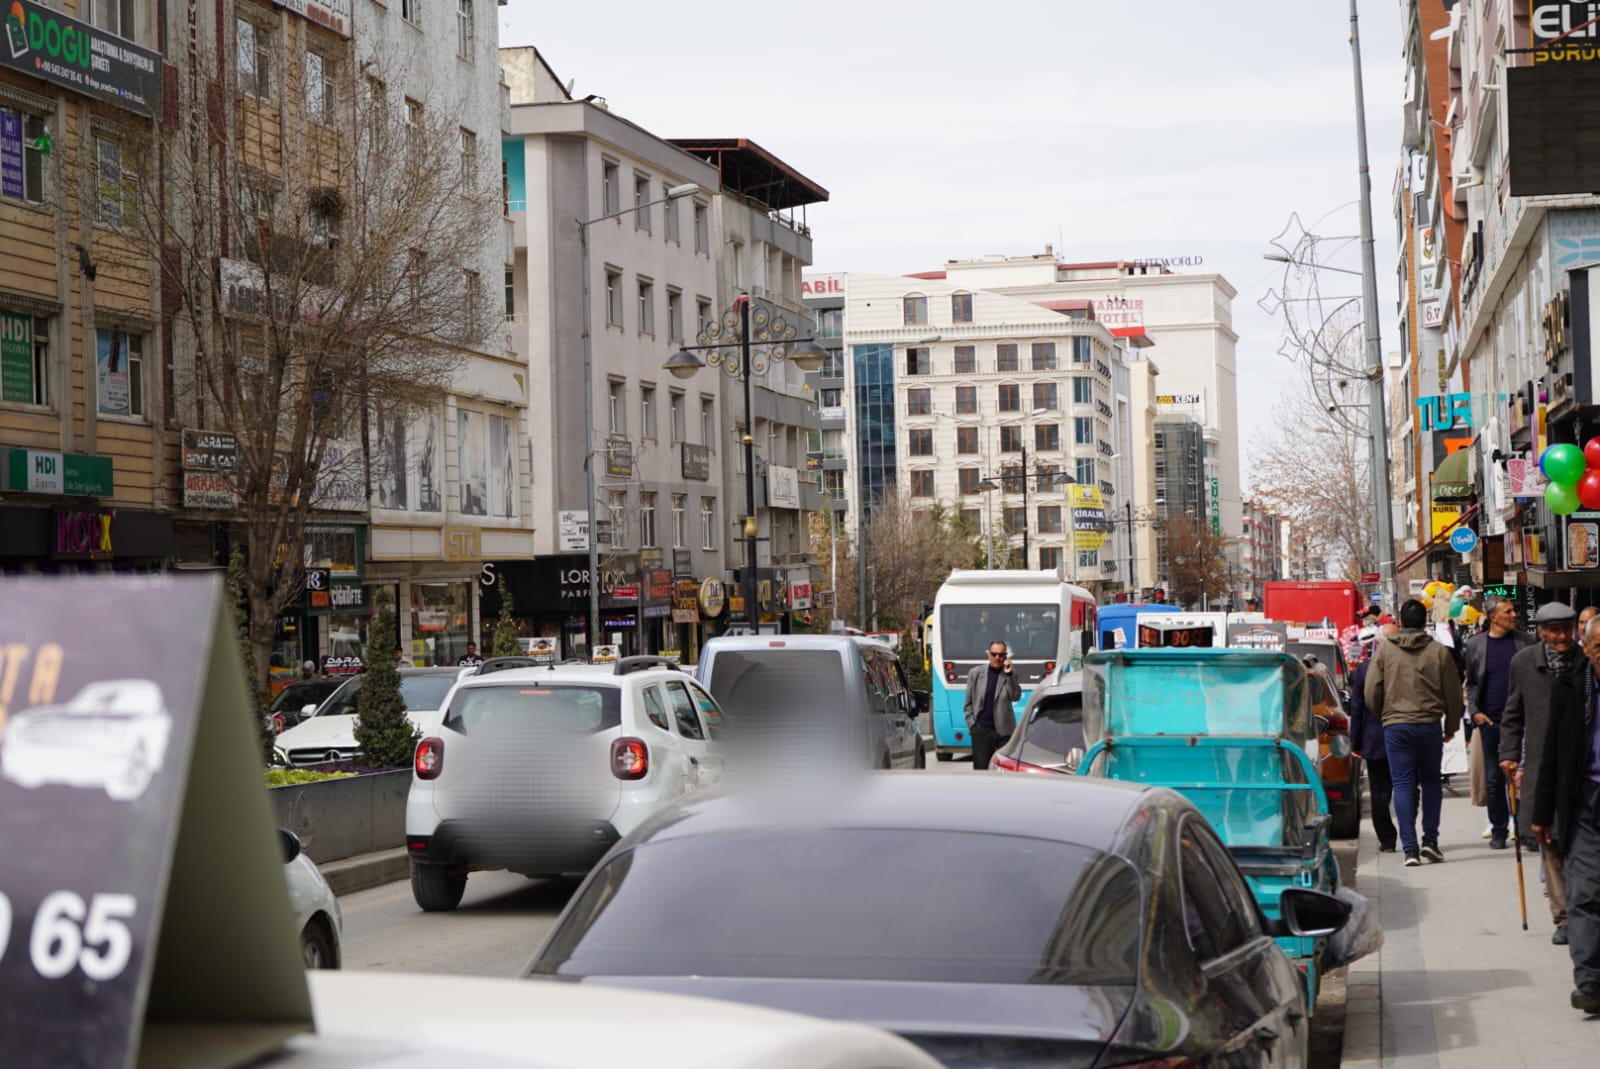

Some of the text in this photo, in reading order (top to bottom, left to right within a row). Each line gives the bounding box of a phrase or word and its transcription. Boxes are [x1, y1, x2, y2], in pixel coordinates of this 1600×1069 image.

[1533, 3, 1600, 38] ELİ
[29, 12, 90, 68] DOĞU
[1535, 43, 1600, 62] SÜRÜ
[1, 316, 29, 343] HDI
[36, 455, 56, 475] HDI
[326, 656, 361, 664] DARA
[29, 889, 138, 981] 65
